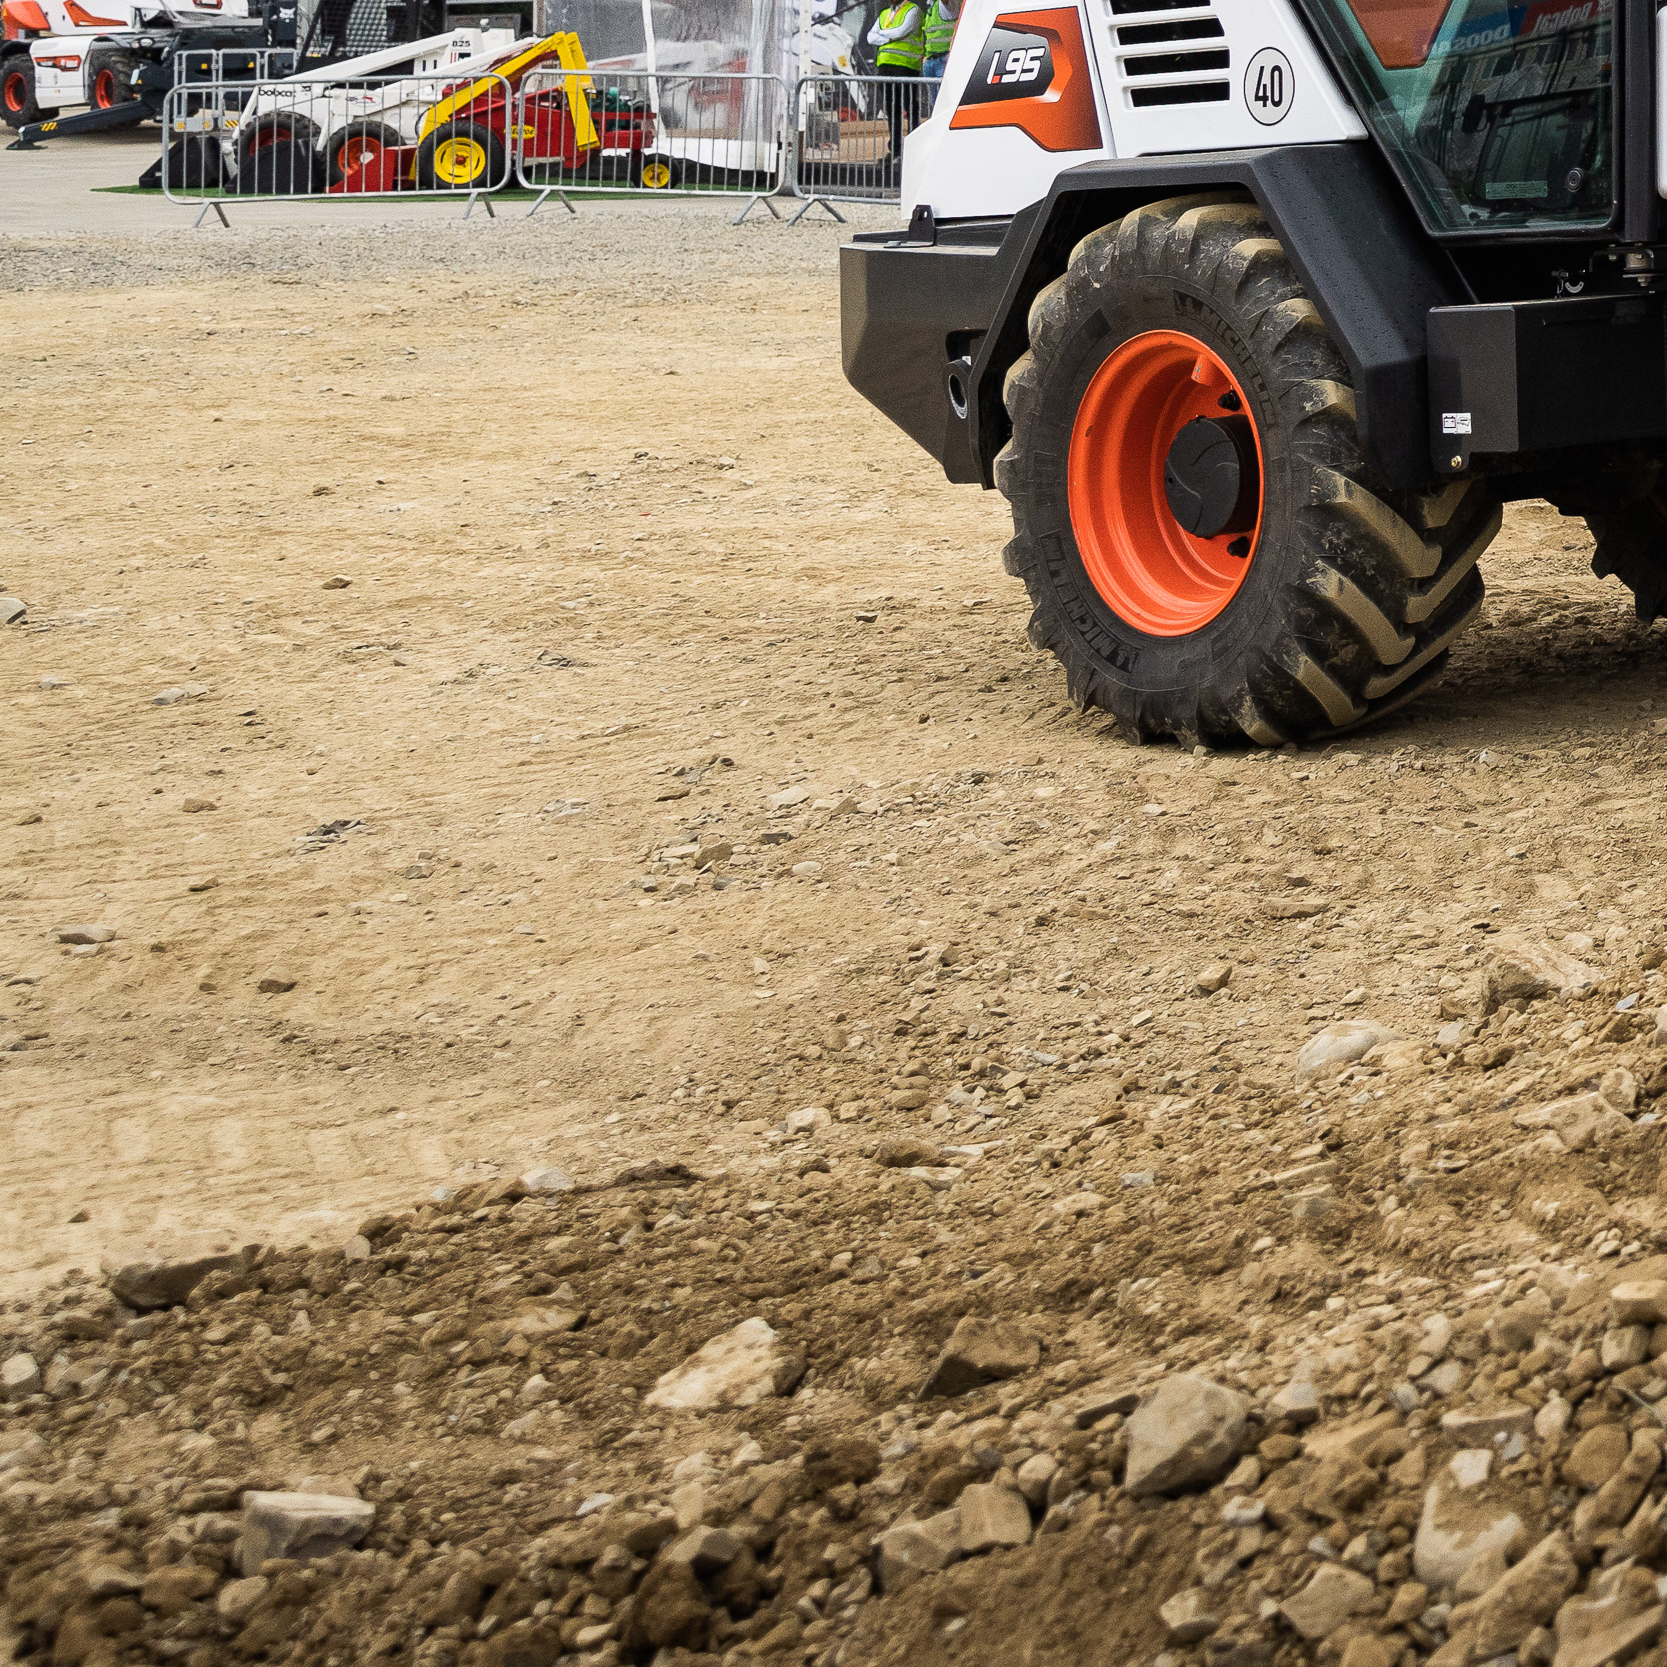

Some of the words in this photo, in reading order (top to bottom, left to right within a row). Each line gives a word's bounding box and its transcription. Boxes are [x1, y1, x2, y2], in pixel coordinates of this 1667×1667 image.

[258, 87, 296, 98] bobca
[1254, 64, 1283, 108] 40
[1199, 302, 1278, 427] MICHELIN
[1040, 537, 1119, 659] MICHELIN
